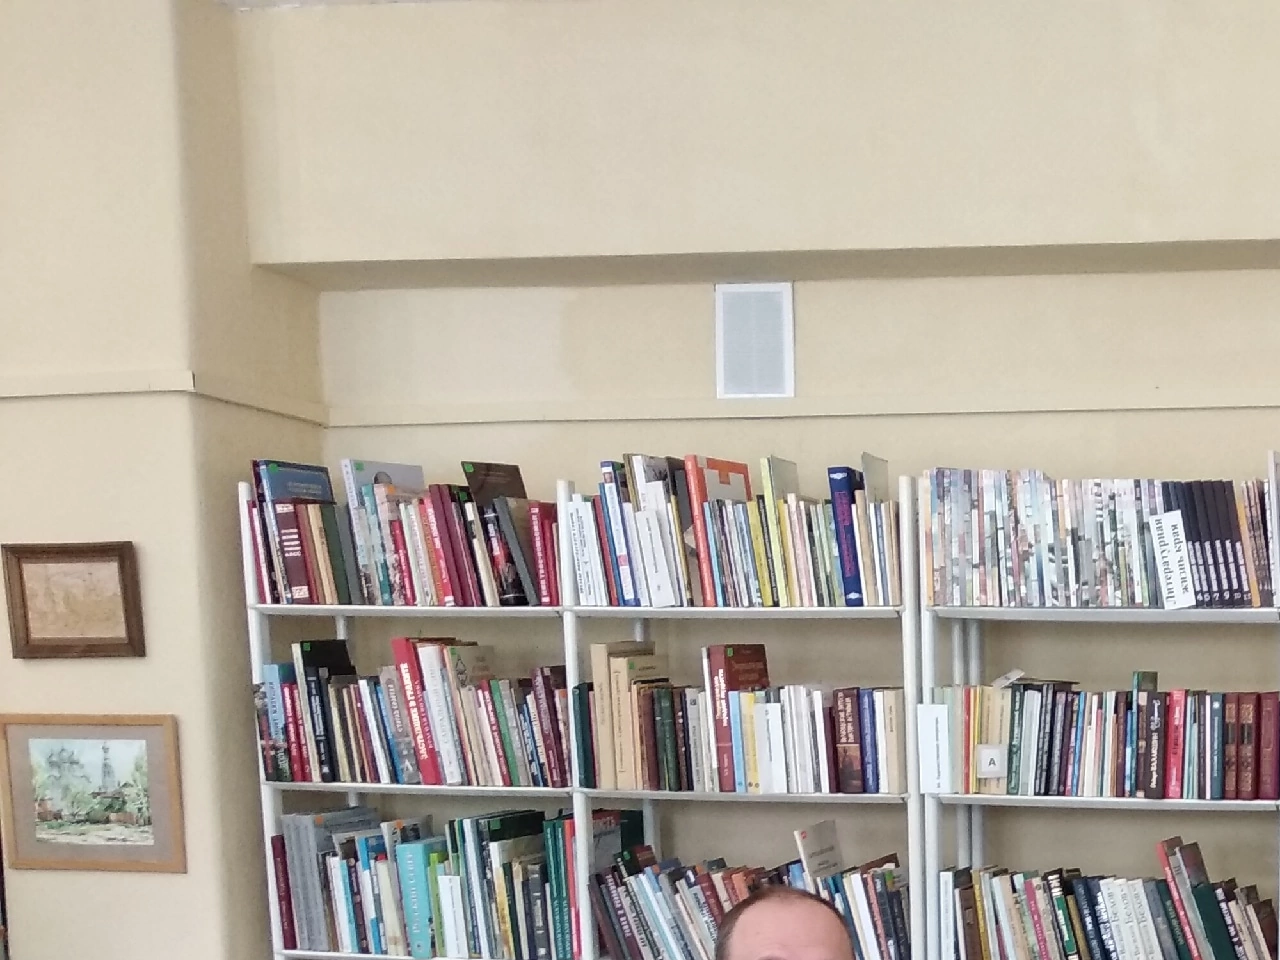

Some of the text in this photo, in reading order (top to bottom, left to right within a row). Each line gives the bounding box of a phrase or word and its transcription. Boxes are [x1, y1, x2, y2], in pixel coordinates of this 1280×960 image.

[1154, 518, 1177, 605] Литературная
[1171, 523, 1189, 594] жизнь края
[988, 757, 997, 767] А
